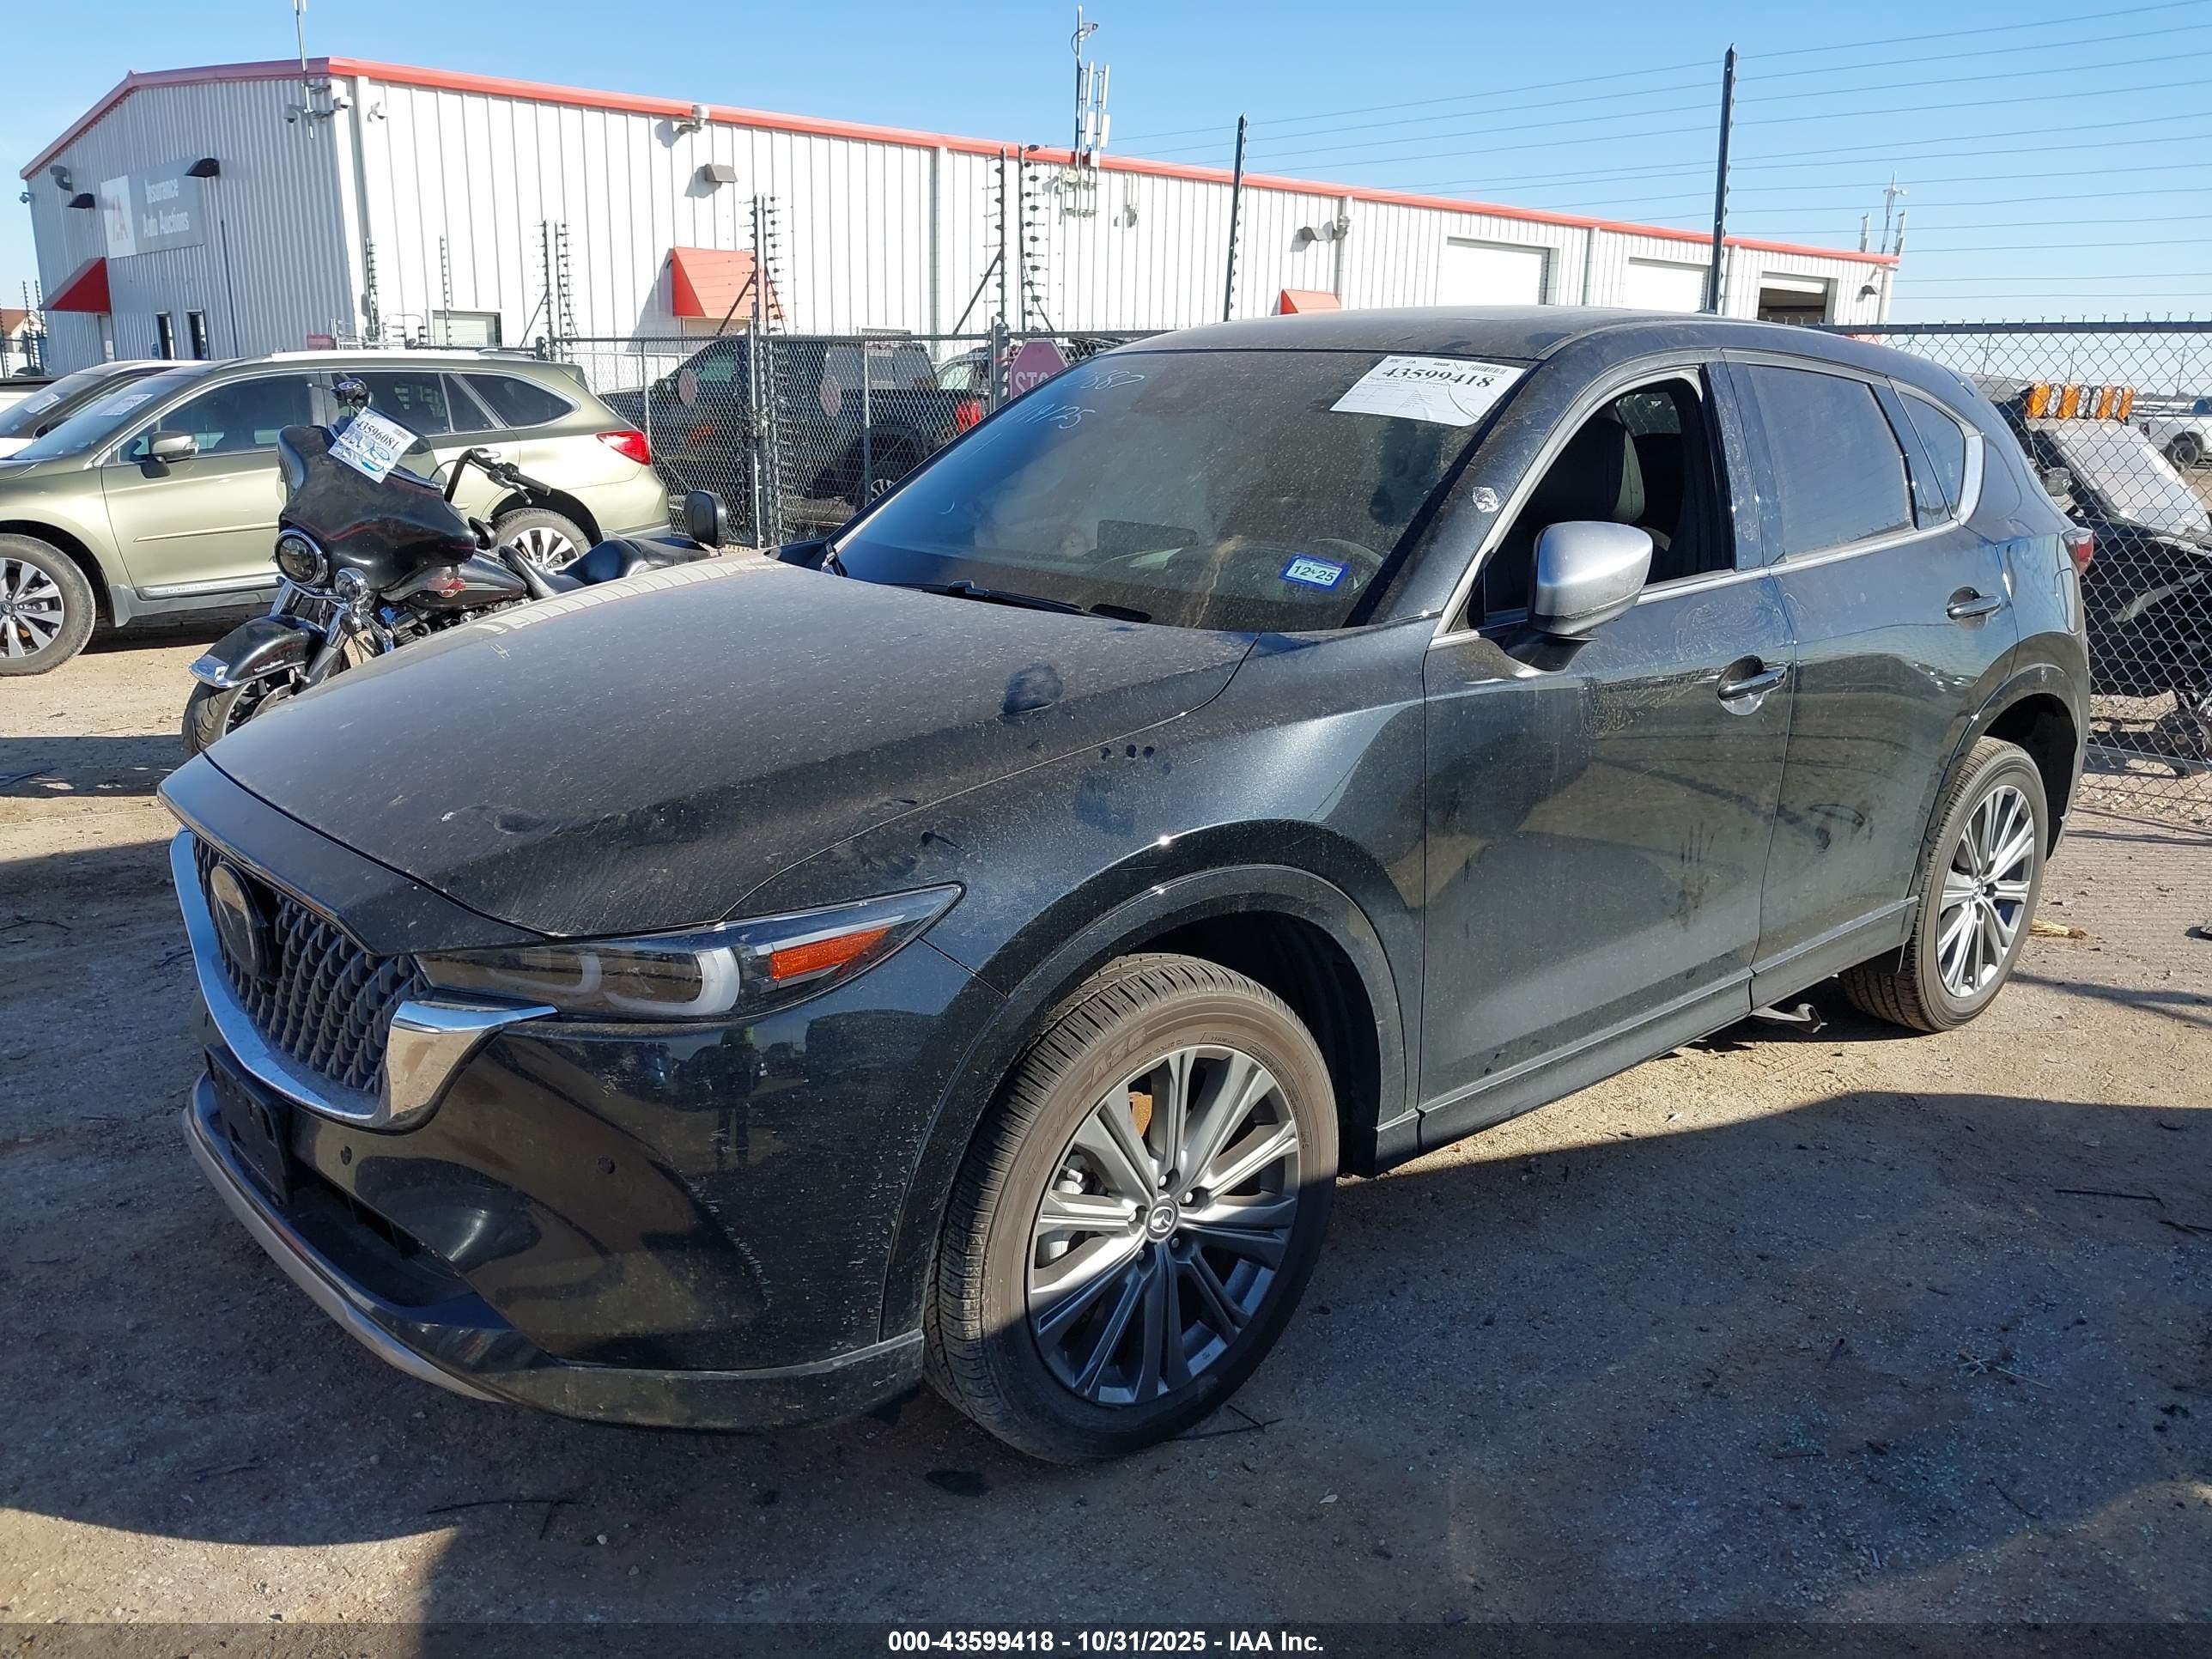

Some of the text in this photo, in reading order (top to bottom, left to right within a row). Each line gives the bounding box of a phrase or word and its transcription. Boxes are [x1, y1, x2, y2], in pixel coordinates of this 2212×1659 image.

[143, 206, 190, 238] Auto Auctions
[1382, 367, 1495, 388] 43599418
[356, 419, 401, 450] 43596081
